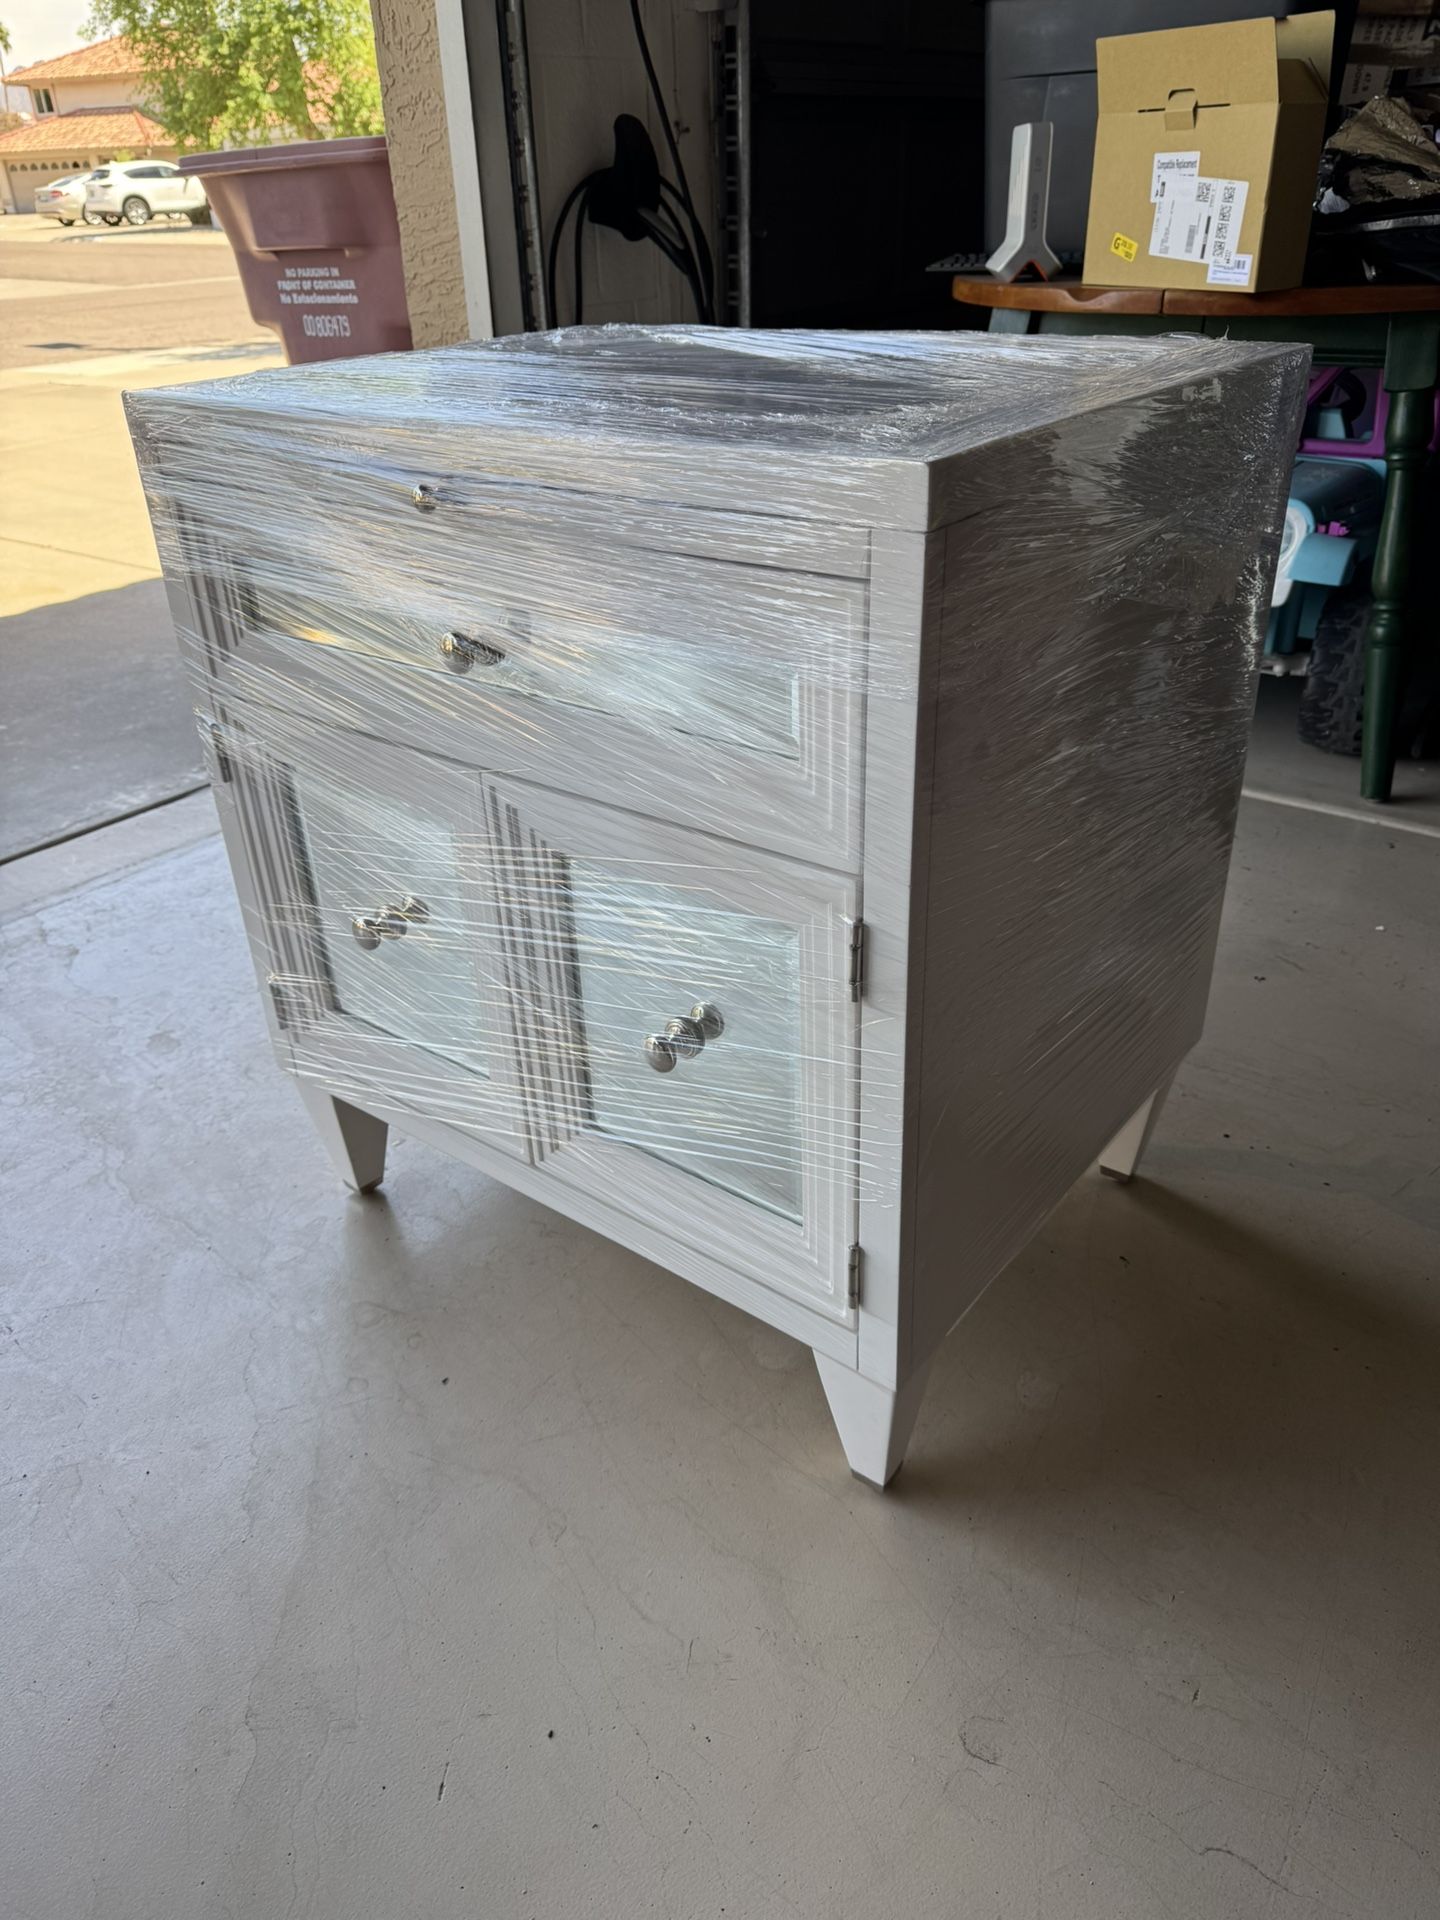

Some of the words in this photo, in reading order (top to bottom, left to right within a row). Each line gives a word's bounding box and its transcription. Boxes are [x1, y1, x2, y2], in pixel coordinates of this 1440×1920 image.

[284, 267, 296, 278] NO
[297, 267, 330, 278] PARKING
[277, 280, 301, 291] FRONT
[301, 280, 312, 290] OF
[313, 279, 356, 290] CONTAINER
